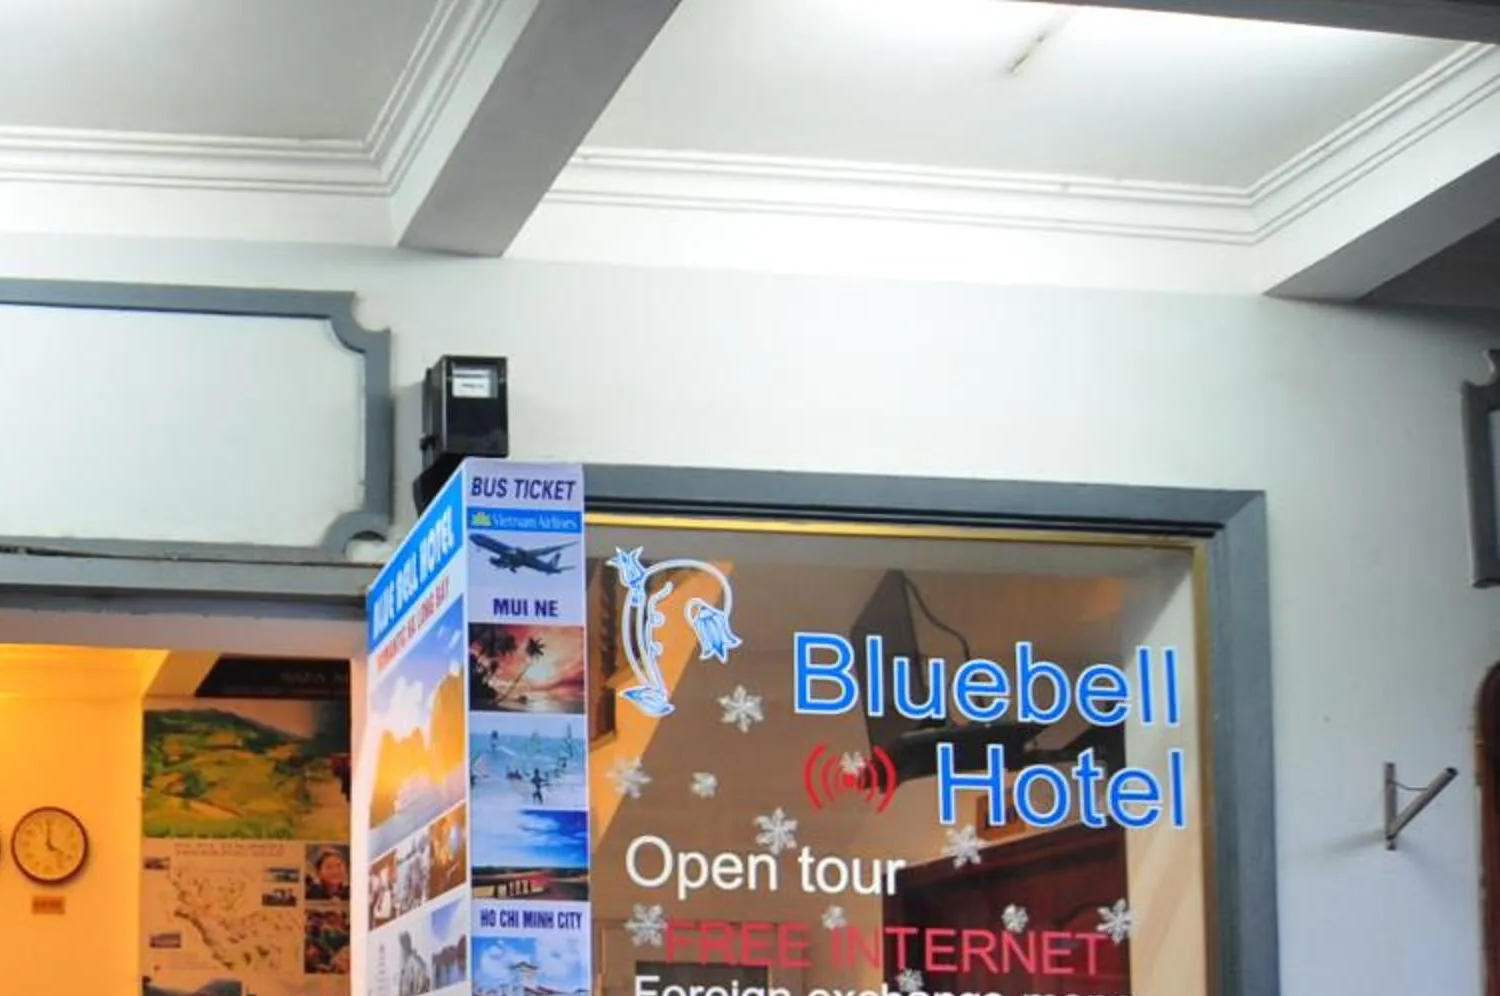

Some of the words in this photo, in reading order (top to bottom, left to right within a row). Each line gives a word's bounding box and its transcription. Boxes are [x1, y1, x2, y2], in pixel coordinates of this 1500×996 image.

[471, 477, 508, 498] BUS
[513, 478, 577, 501] TICKET
[419, 504, 455, 584] HOTEL
[538, 513, 578, 531] Airlines
[493, 598, 529, 616] MUI
[536, 600, 559, 617] NE
[793, 632, 1180, 726] Bluebell
[936, 743, 1186, 830] Hotel
[625, 835, 778, 899] Open
[798, 846, 907, 895] tour
[481, 908, 496, 928] HO
[500, 910, 519, 928] CHI
[523, 911, 554, 929] MINH
[557, 911, 582, 930] CITY
[663, 921, 810, 967] FREE
[831, 927, 1105, 977] INTERNET
